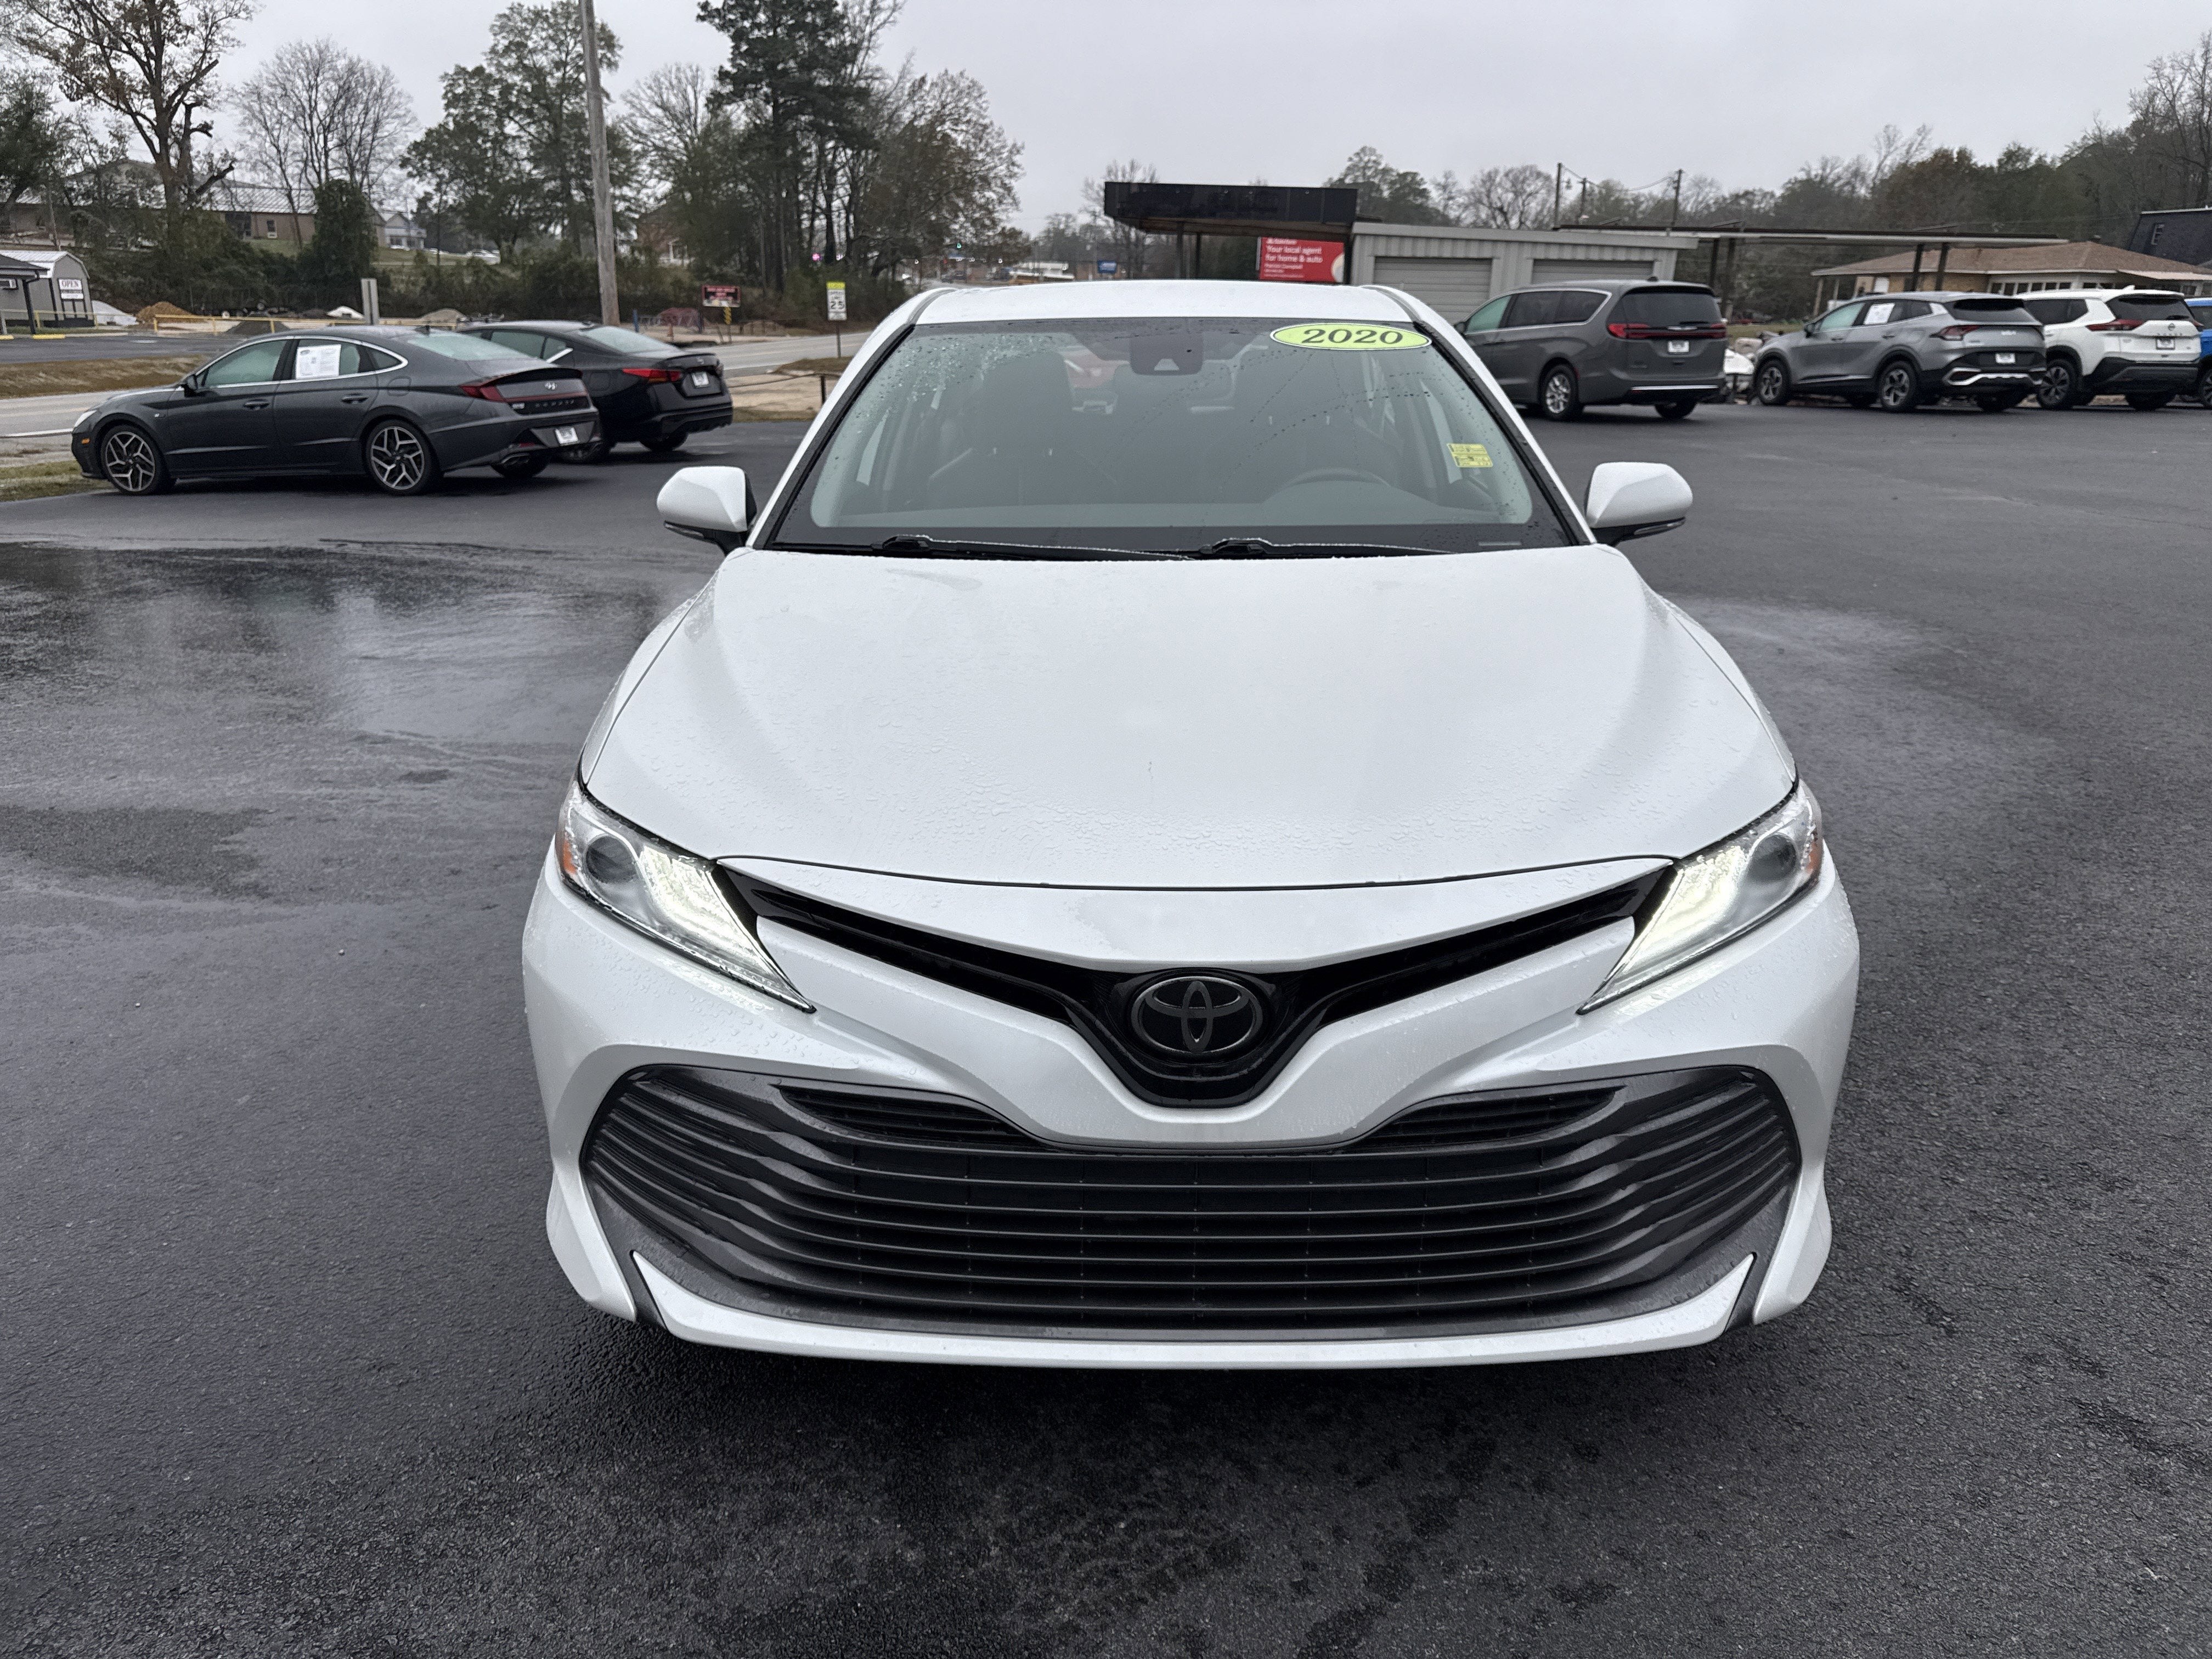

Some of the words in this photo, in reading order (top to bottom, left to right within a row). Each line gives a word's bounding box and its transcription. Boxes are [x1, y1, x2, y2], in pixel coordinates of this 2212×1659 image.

[1283, 246, 1301, 254] local
[1302, 247, 1322, 256] agent
[1265, 253, 1277, 262] for
[1278, 254, 1298, 262] home
[1299, 255, 1305, 263] &
[830, 301, 845, 309] 25
[1301, 329, 1403, 345] 2020
